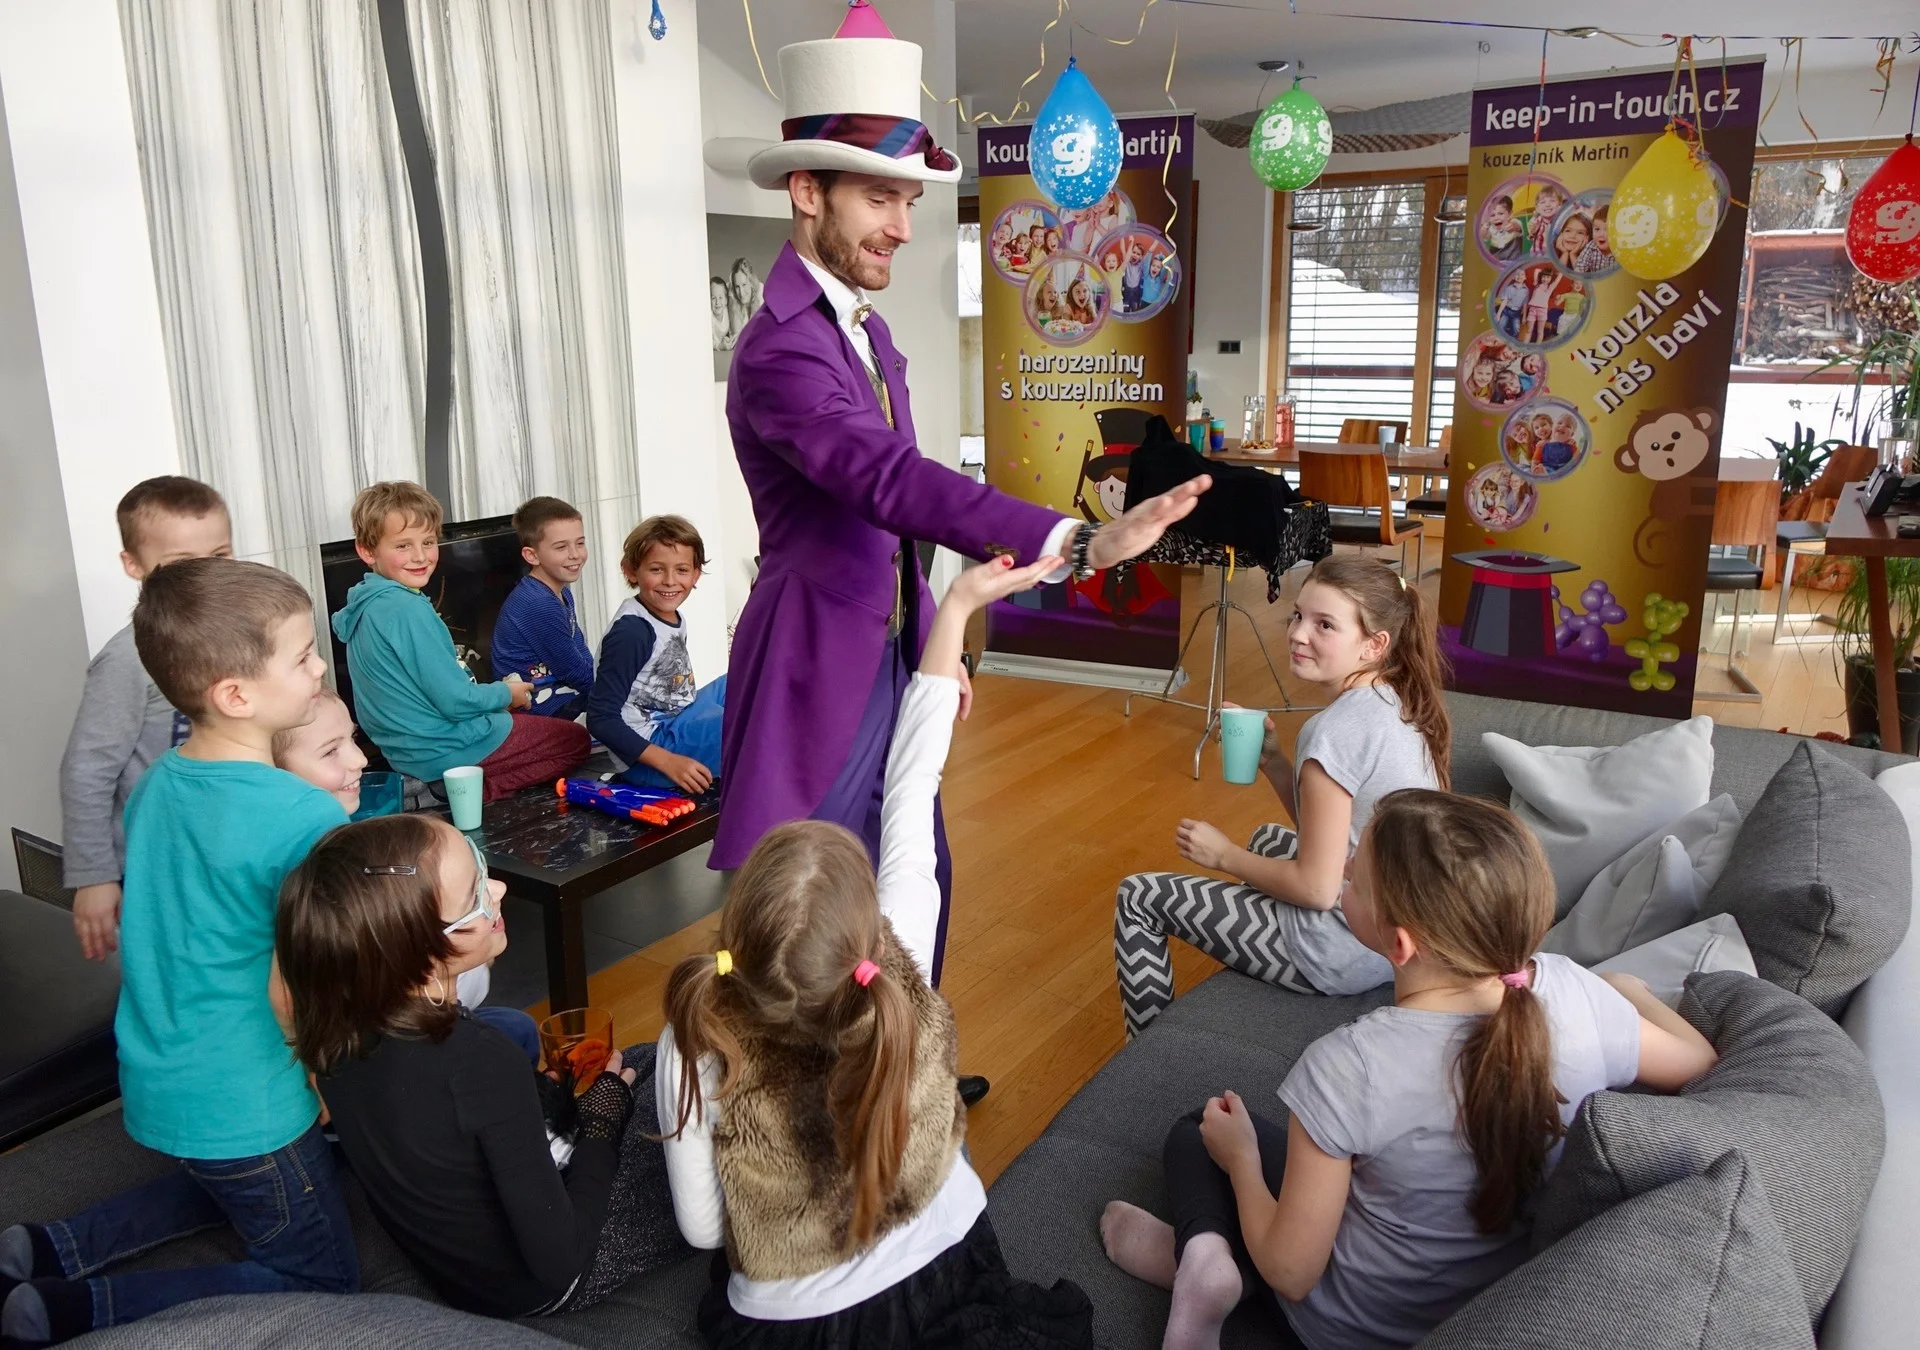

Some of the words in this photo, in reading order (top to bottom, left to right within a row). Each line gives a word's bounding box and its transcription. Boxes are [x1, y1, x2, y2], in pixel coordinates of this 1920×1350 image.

[986, 139, 1032, 163] kou
[1119, 129, 1182, 160] artin
[1261, 113, 1294, 152] 9
[1571, 143, 1629, 162] Martin
[1052, 132, 1093, 177] 9
[1615, 204, 1659, 249] 9
[1875, 200, 1920, 245] 9
[1574, 282, 1681, 375] kouzla
[1018, 348, 1146, 379] narozeniny
[1593, 358, 1655, 415] nás
[1645, 289, 1723, 361] baví
[1001, 381, 1013, 400] s
[1021, 376, 1164, 402] kouzelníkem
